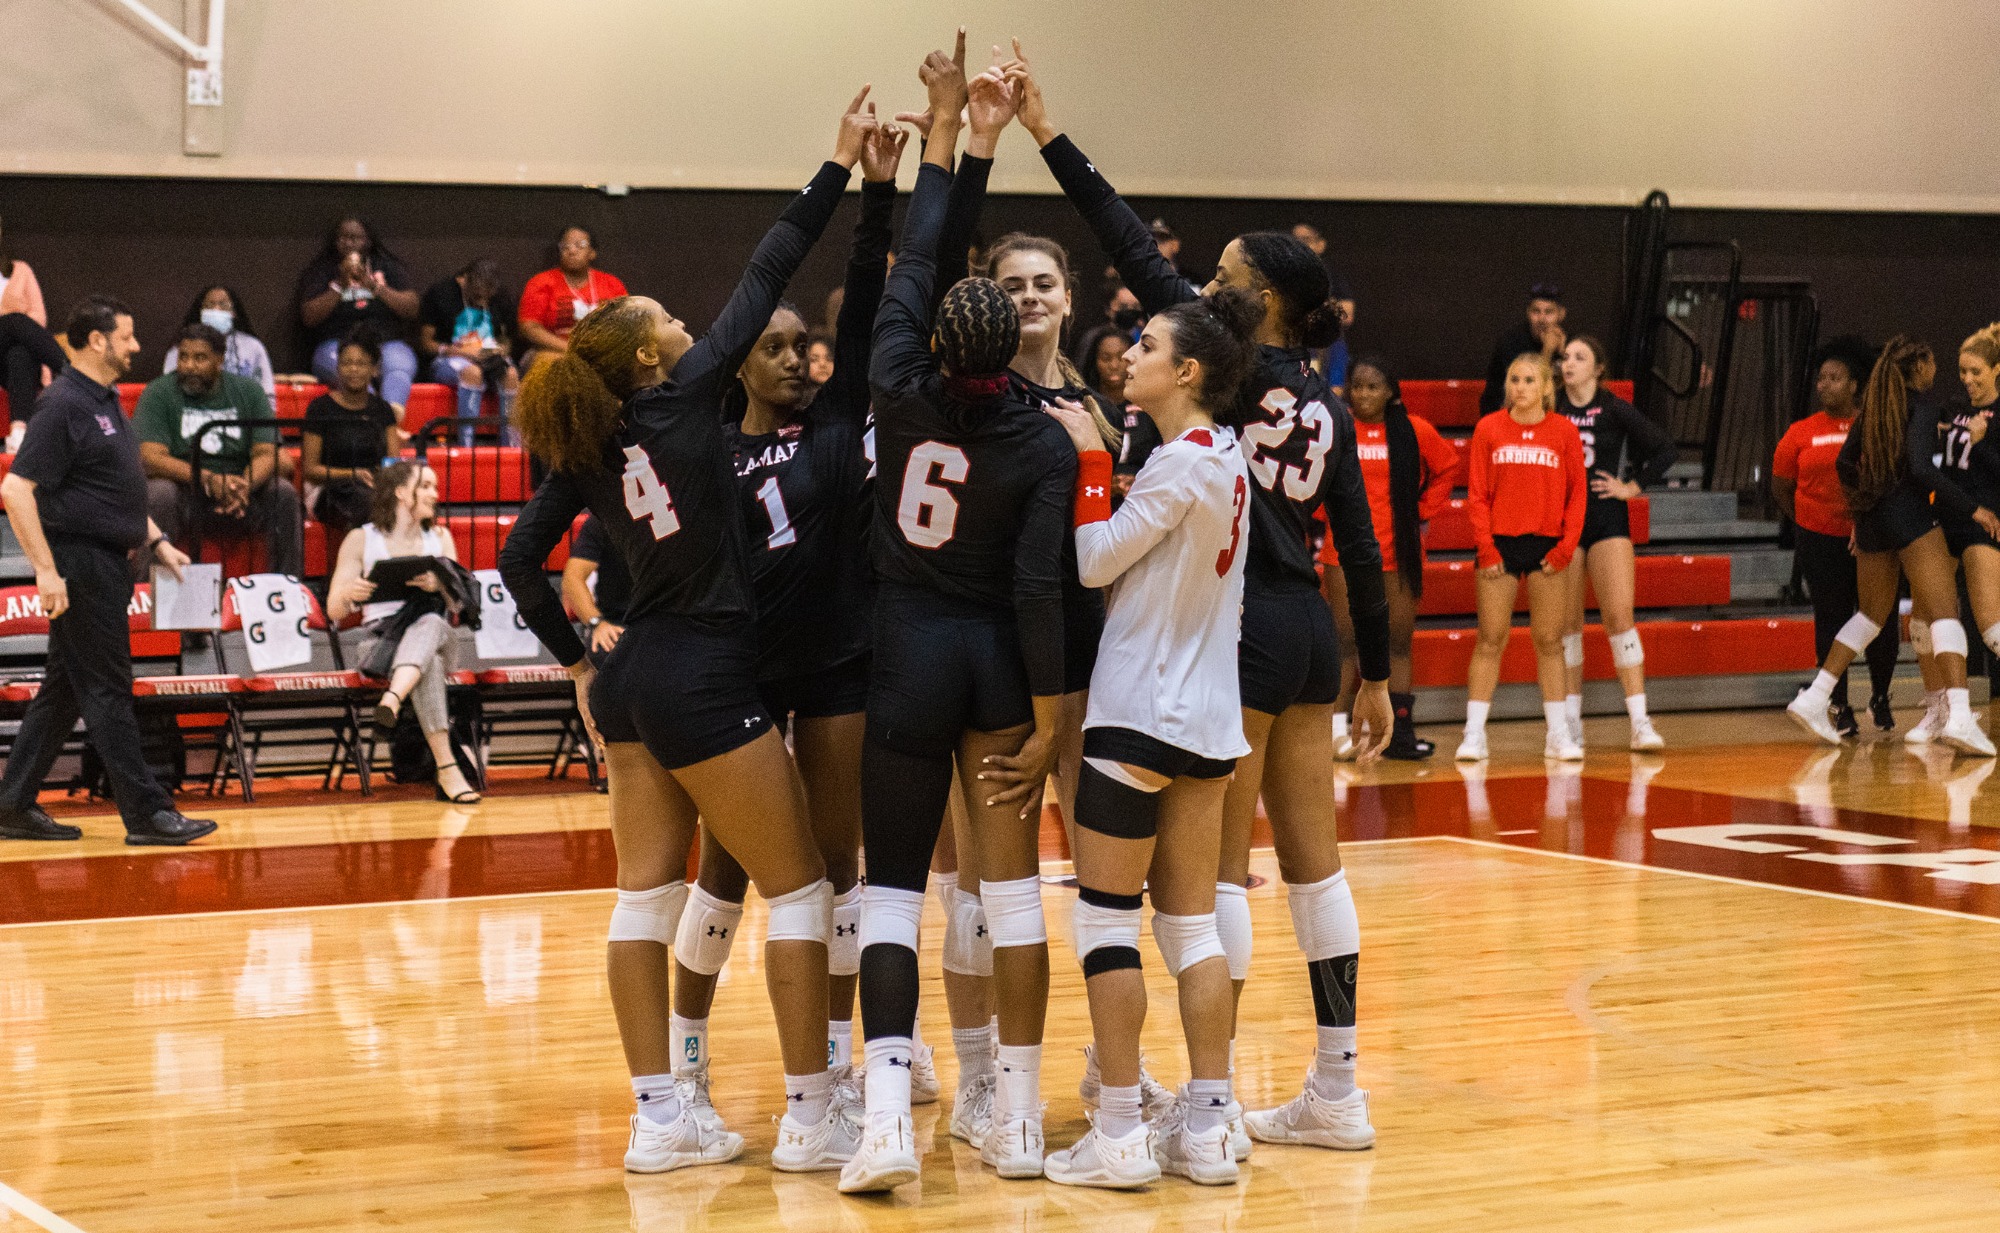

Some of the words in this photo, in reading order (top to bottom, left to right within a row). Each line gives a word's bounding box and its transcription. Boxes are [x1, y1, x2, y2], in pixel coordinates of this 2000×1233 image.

[734, 441, 799, 477] AMA
[1239, 387, 1334, 502] 23
[1492, 448, 1559, 469] CARDINALS
[1945, 428, 1971, 471] 17
[622, 443, 681, 542] 4
[896, 440, 971, 550] 6
[755, 475, 797, 551] 1
[1215, 474, 1247, 579] 3
[267, 591, 286, 613] G
[487, 583, 504, 603] G
[249, 621, 267, 644] G
[154, 681, 230, 696] VOLLEYBALL
[273, 676, 348, 691] VOLLEYBALL
